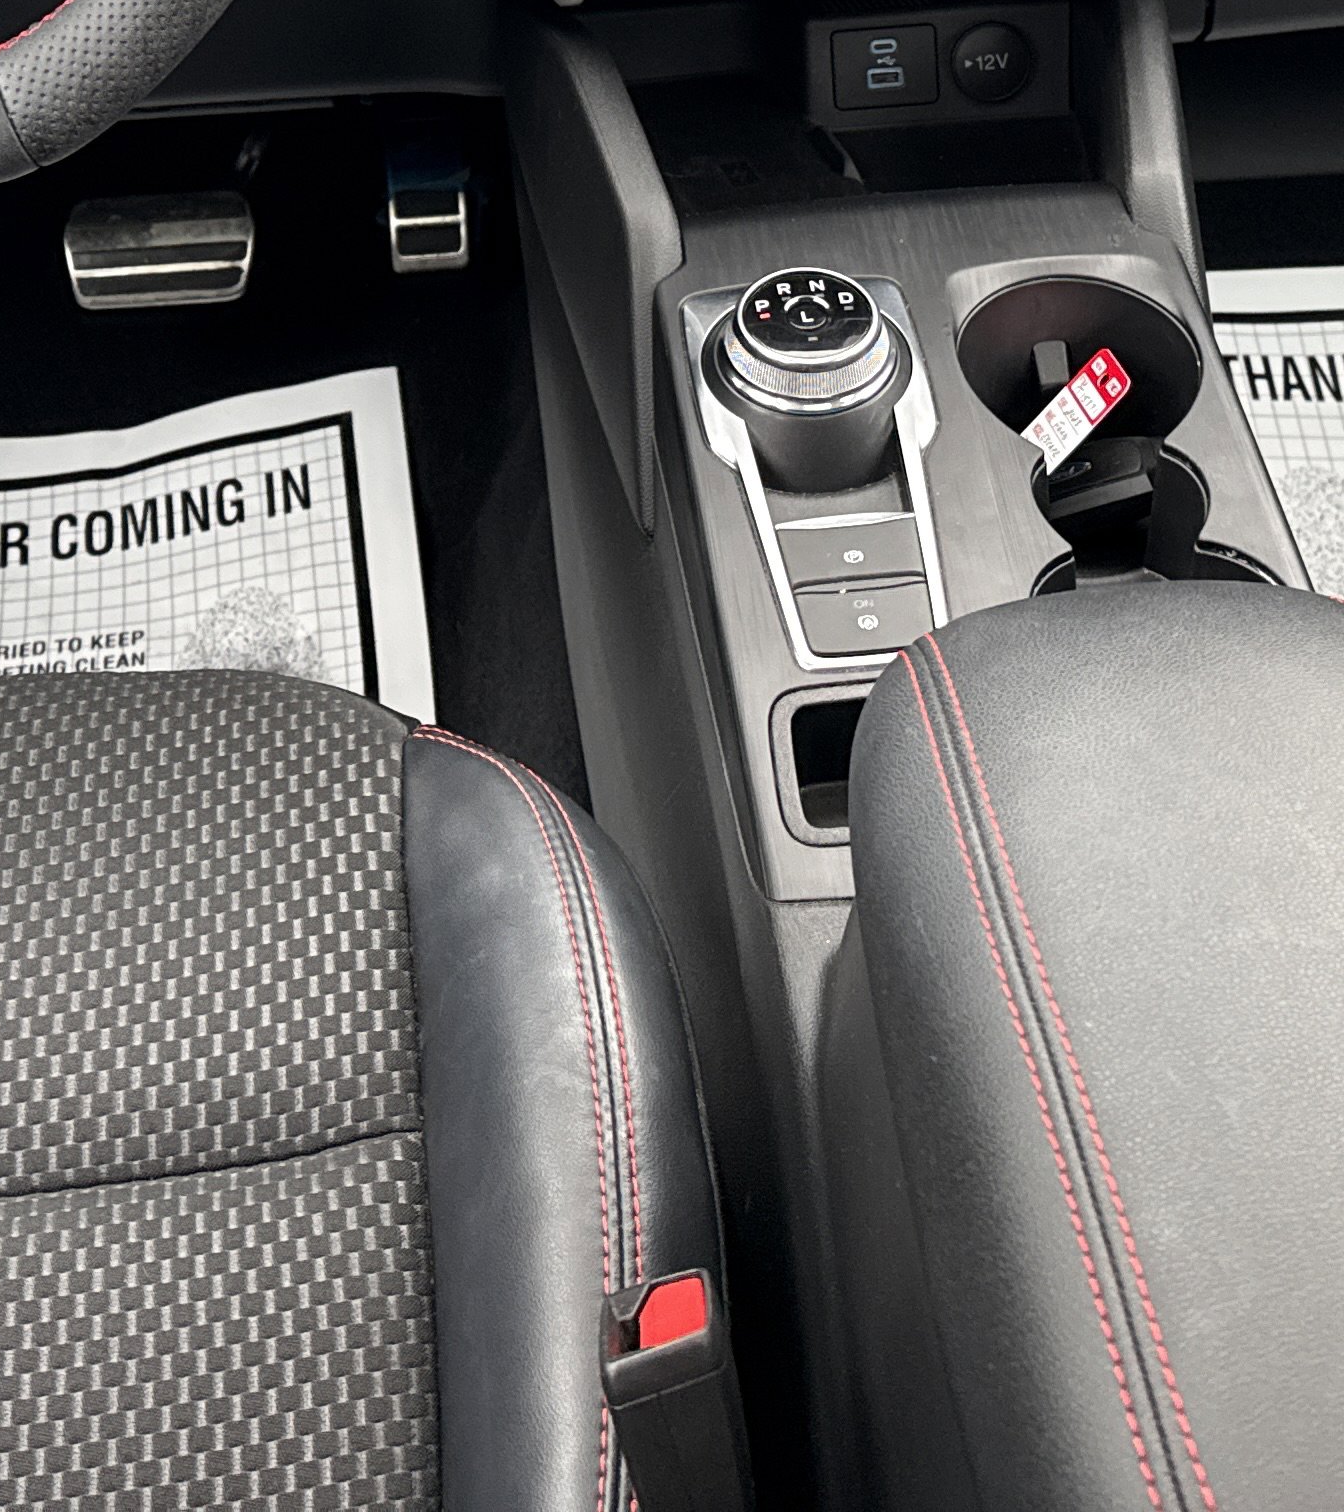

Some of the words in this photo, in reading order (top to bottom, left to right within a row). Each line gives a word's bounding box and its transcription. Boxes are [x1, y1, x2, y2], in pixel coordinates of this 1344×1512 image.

[975, 52, 1009, 72] 12V
[776, 282, 792, 296] R
[808, 279, 826, 292] N
[837, 291, 854, 305] D
[754, 299, 770, 313] P
[800, 311, 815, 323] L
[50, 478, 245, 560] COMING
[264, 463, 312, 518] IN
[54, 637, 83, 653] TO
[90, 630, 145, 649] KEEP
[75, 651, 145, 674] CLEAN
